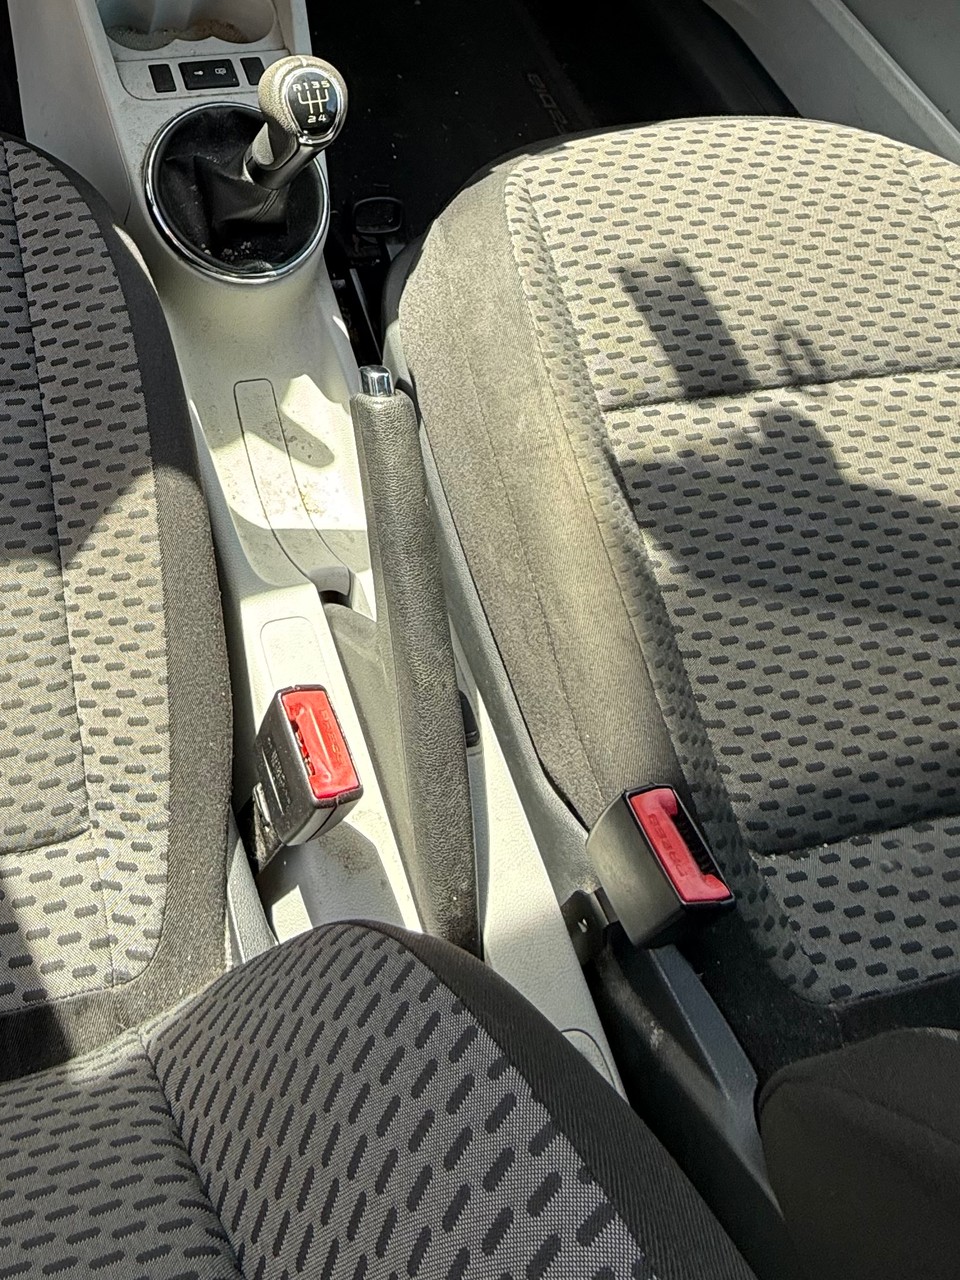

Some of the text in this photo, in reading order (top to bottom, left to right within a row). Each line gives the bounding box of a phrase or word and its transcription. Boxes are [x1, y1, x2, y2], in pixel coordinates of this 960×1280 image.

[292, 83, 302, 92] R
[310, 81, 320, 89] 3
[321, 80, 331, 88] 5
[307, 114, 327, 124] 2 4
